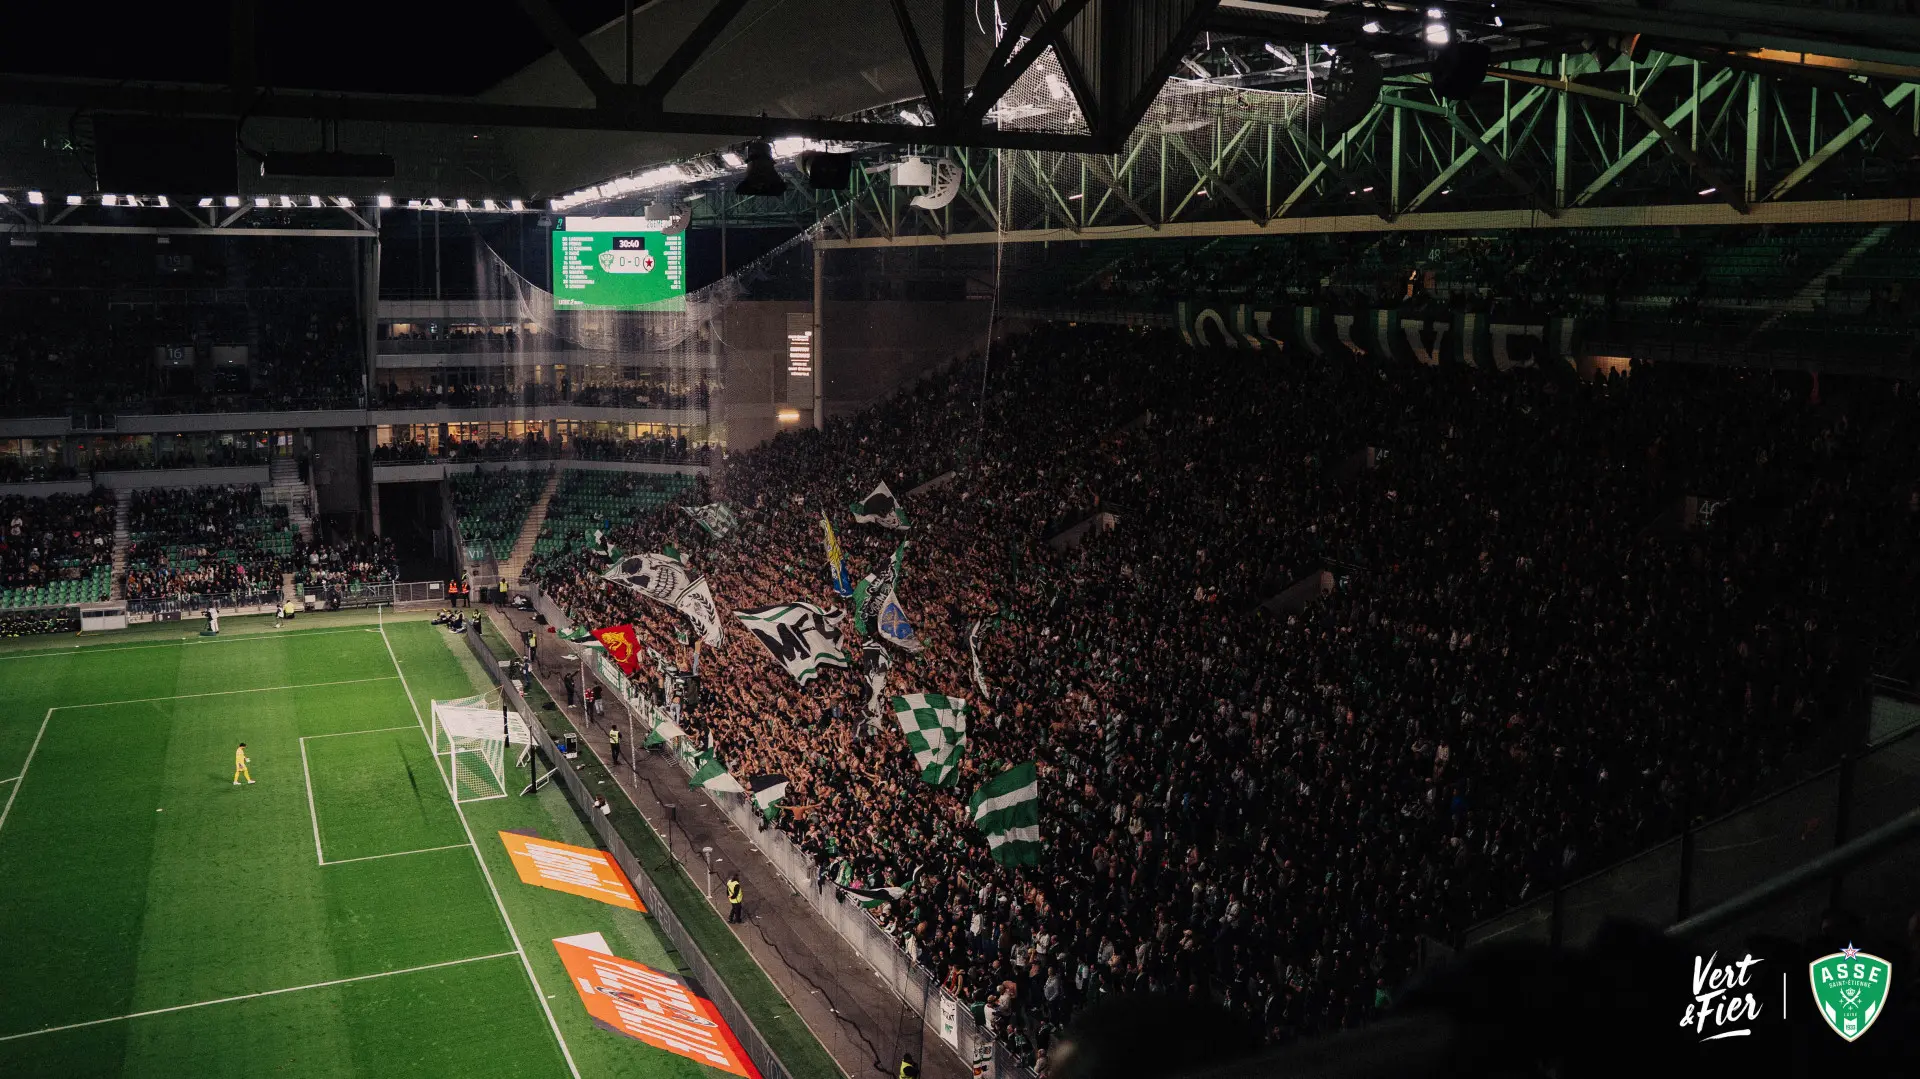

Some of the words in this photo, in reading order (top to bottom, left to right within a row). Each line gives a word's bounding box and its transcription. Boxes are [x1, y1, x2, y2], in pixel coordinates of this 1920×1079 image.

[619, 239, 640, 248] 30:40
[620, 256, 626, 267] 0
[635, 256, 640, 267] 0
[168, 348, 182, 359] 16
